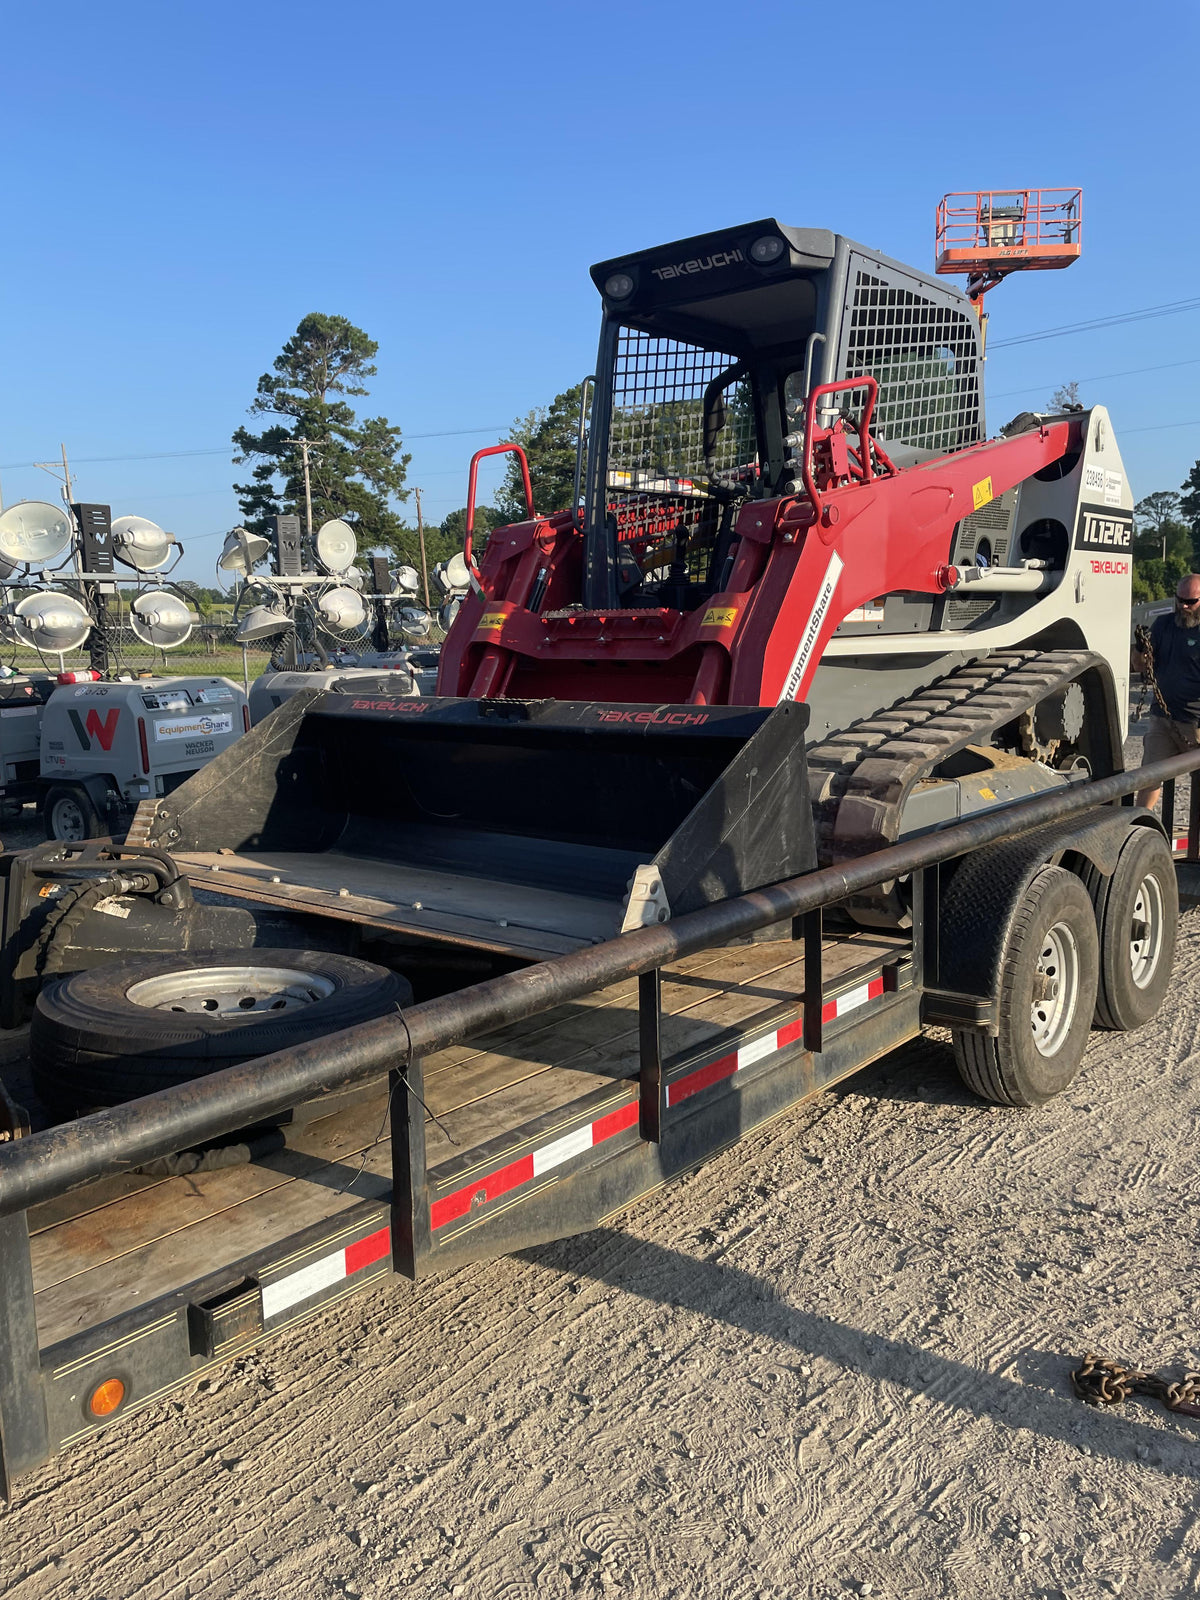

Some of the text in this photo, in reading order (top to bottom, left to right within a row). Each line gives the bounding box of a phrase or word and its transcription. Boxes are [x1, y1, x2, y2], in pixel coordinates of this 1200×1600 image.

[783, 582, 832, 702] quipmentShare
[159, 721, 230, 735] EquipmentShare
[185, 740, 214, 749] WACKER
[185, 747, 215, 756] NEUSON
